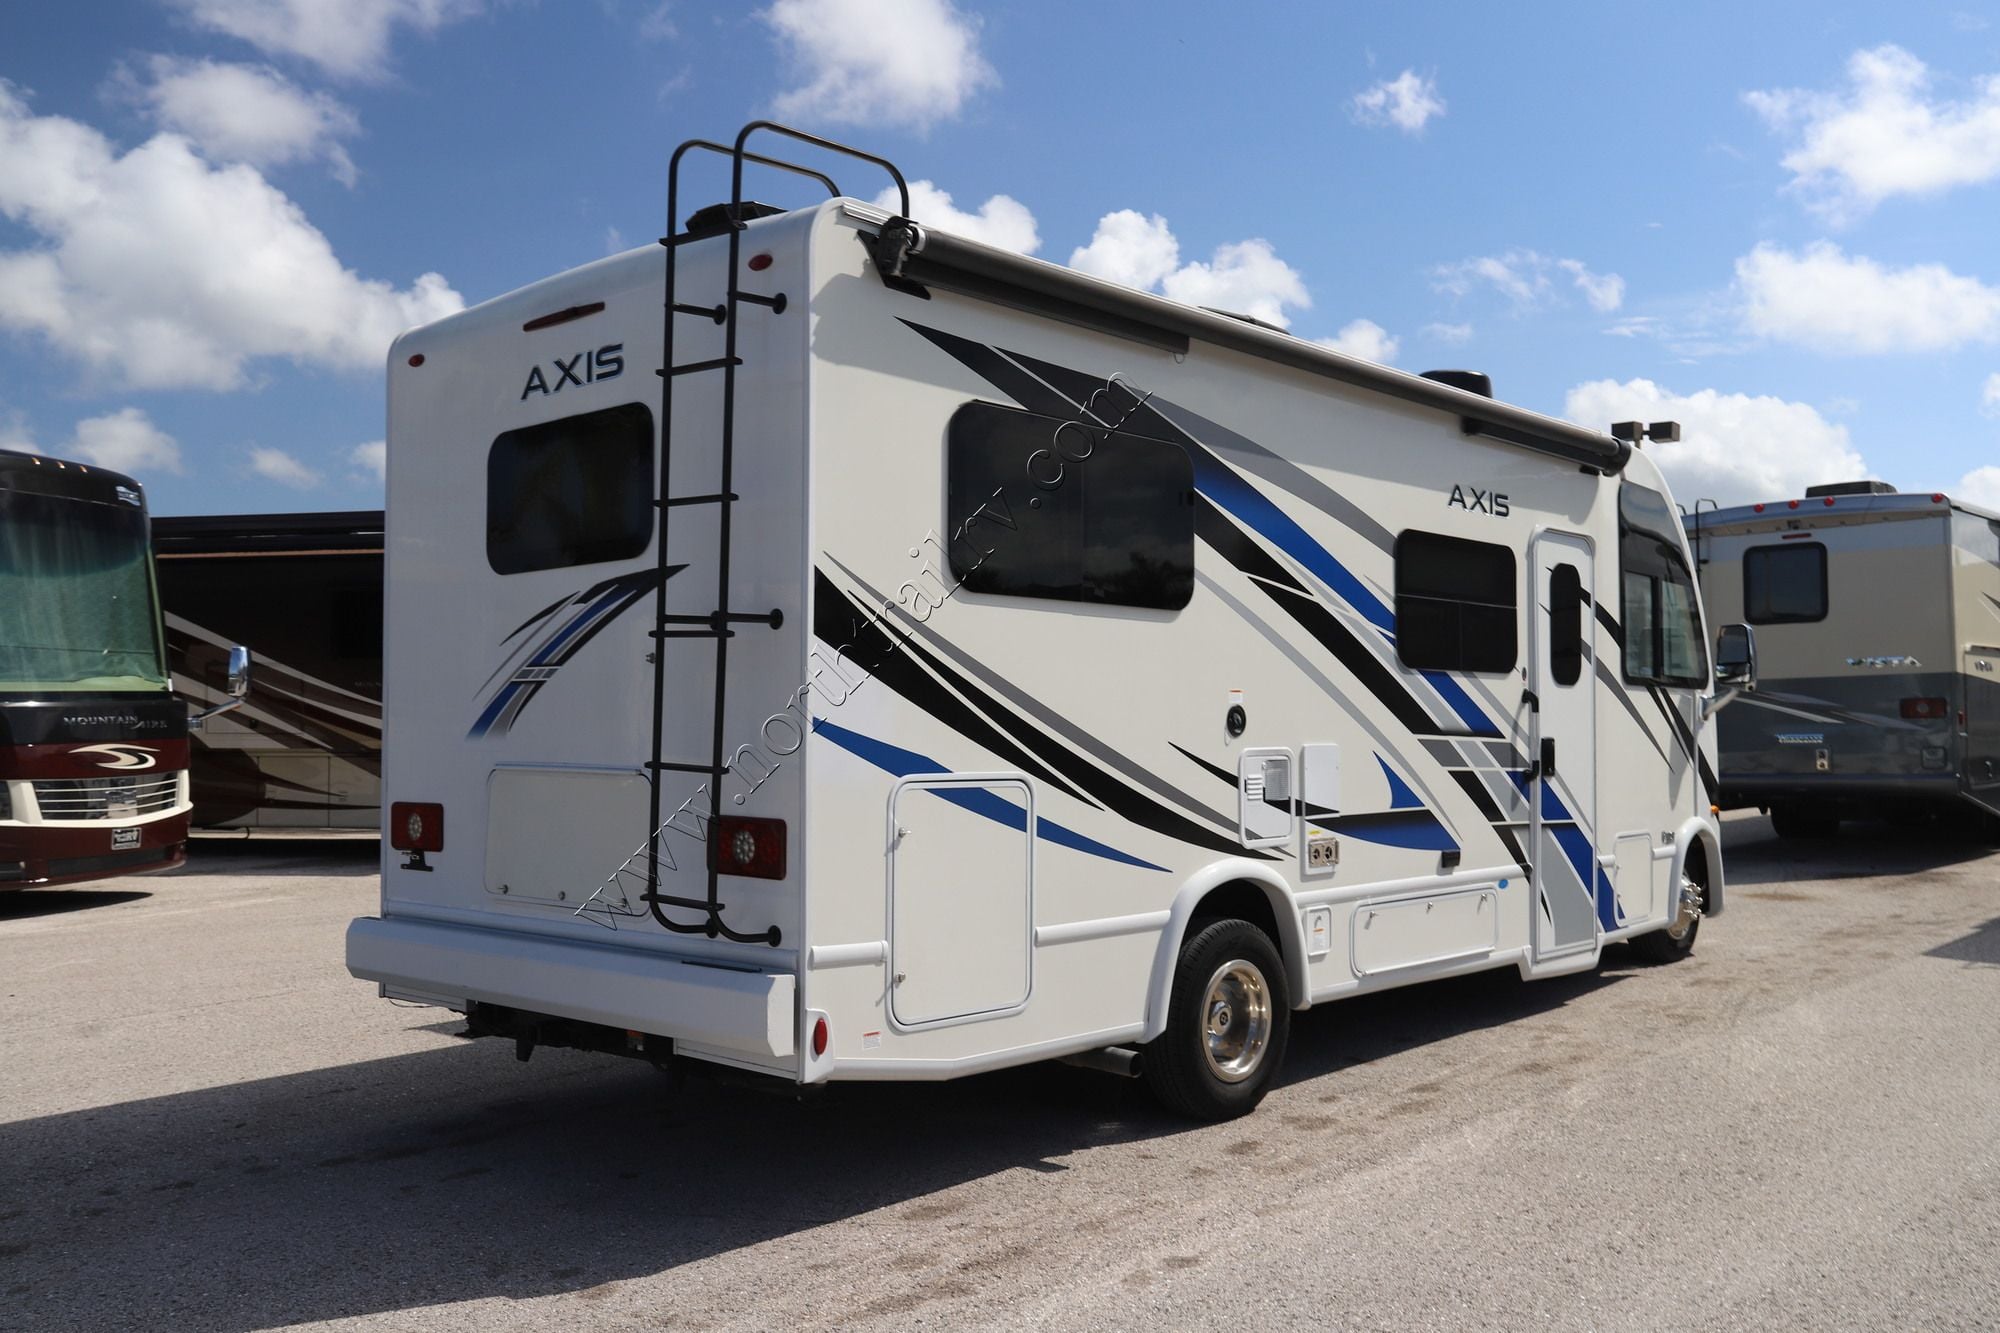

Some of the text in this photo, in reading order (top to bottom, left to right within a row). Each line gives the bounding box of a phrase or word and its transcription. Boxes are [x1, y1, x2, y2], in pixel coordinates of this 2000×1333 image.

[520, 343, 624, 402] AXIS
[1447, 484, 1510, 518] AXIS
[63, 715, 139, 726] MOUNTAIN
